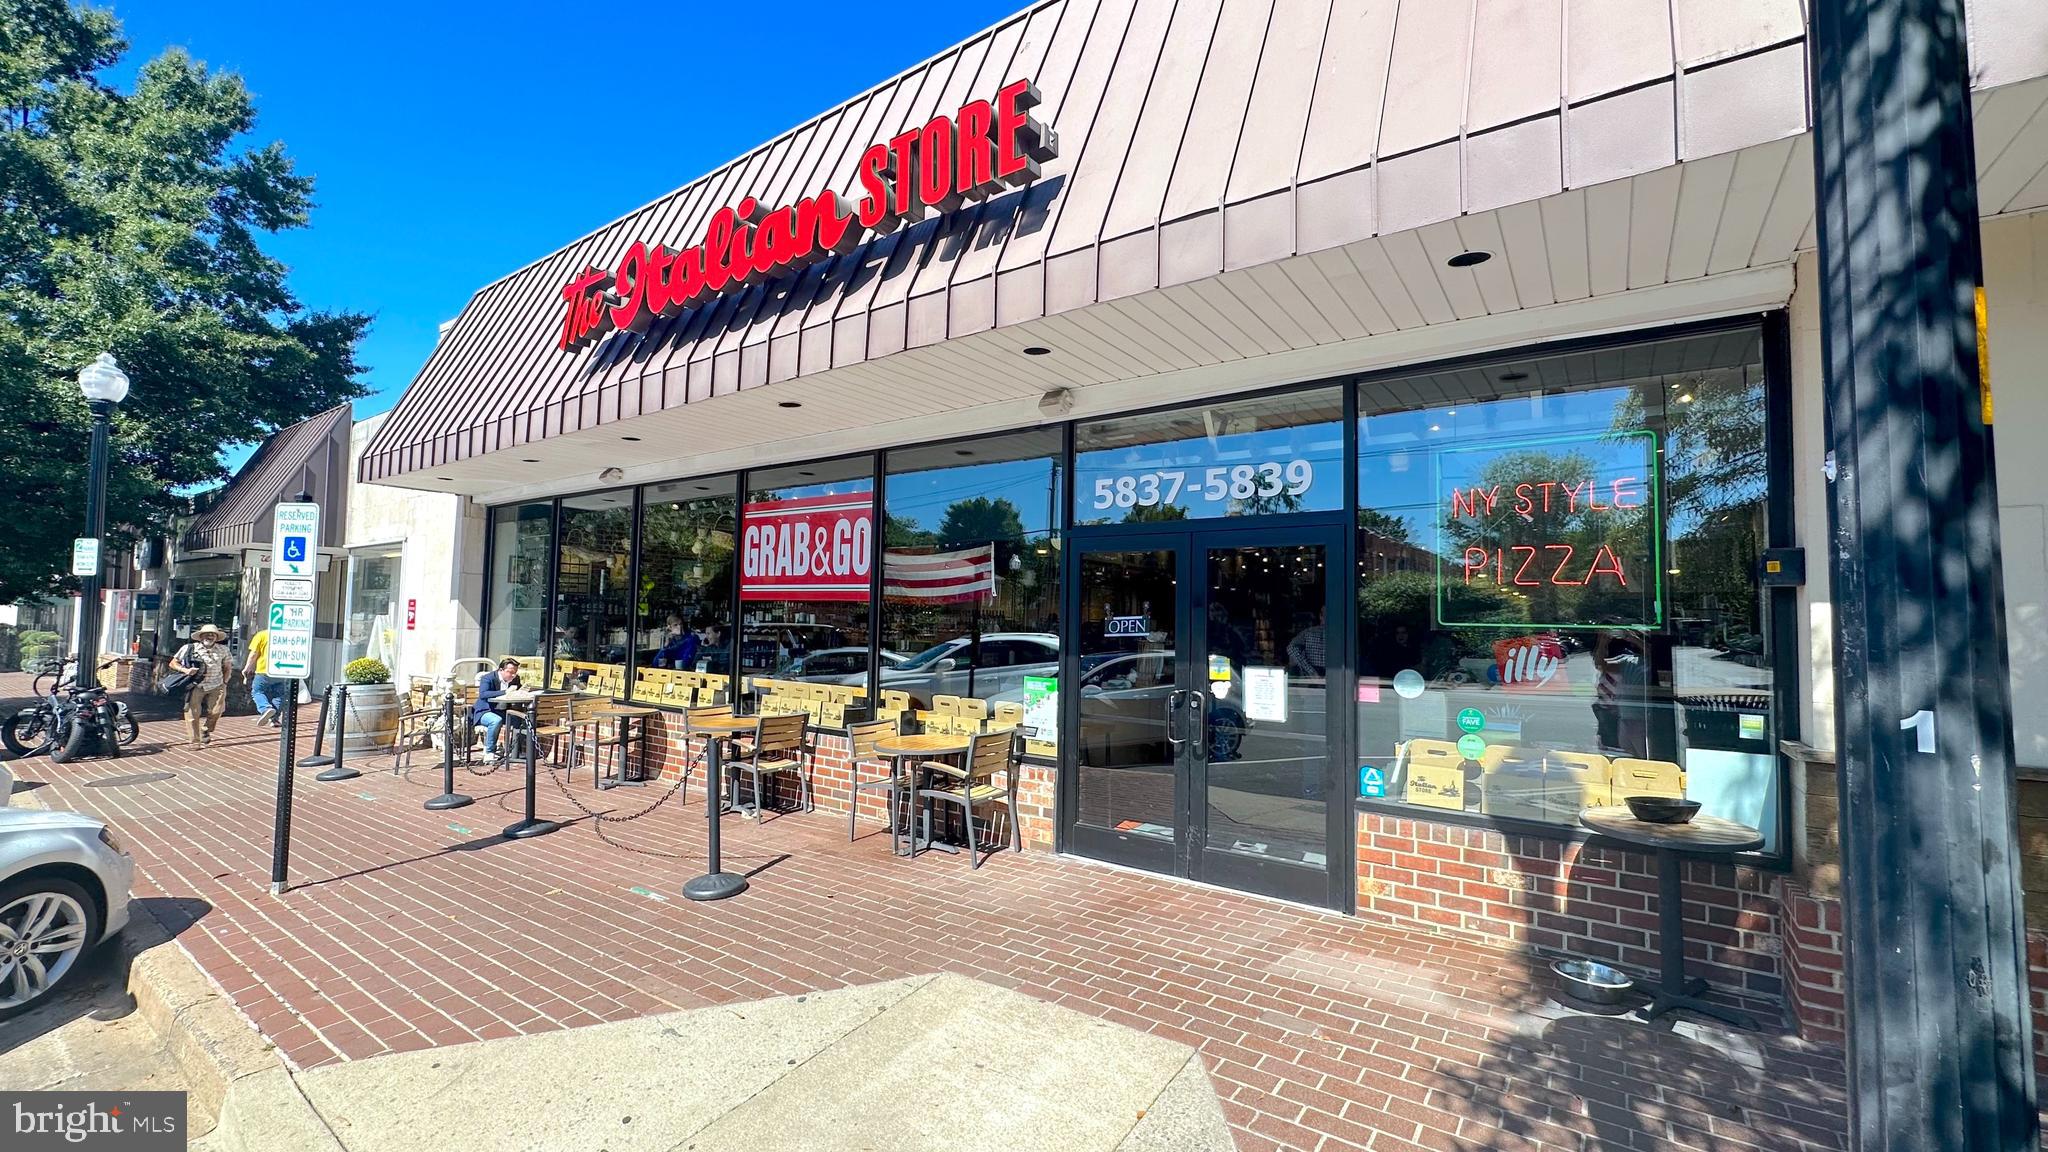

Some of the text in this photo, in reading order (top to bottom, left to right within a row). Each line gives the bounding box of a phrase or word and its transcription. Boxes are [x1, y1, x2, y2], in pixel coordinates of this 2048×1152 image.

[558, 77, 1030, 350] The Italian STORE
[1094, 459, 1313, 510] 5837-5839
[1453, 476, 1638, 519] NY STYLE
[278, 511, 315, 521] RESERVED
[280, 523, 312, 534] PARKING
[743, 516, 872, 578] GRAB&GO
[1463, 543, 1627, 587] PIZZA
[271, 606, 304, 628] 2 HR
[283, 618, 310, 629] PARKING
[1107, 619, 1147, 634] OPEN
[272, 635, 307, 646] 8AM-6PM
[271, 649, 306, 661] MON-SUN
[1503, 645, 1559, 688] illy
[1462, 718, 1481, 726] FAVE
[1899, 709, 1937, 754] 1
